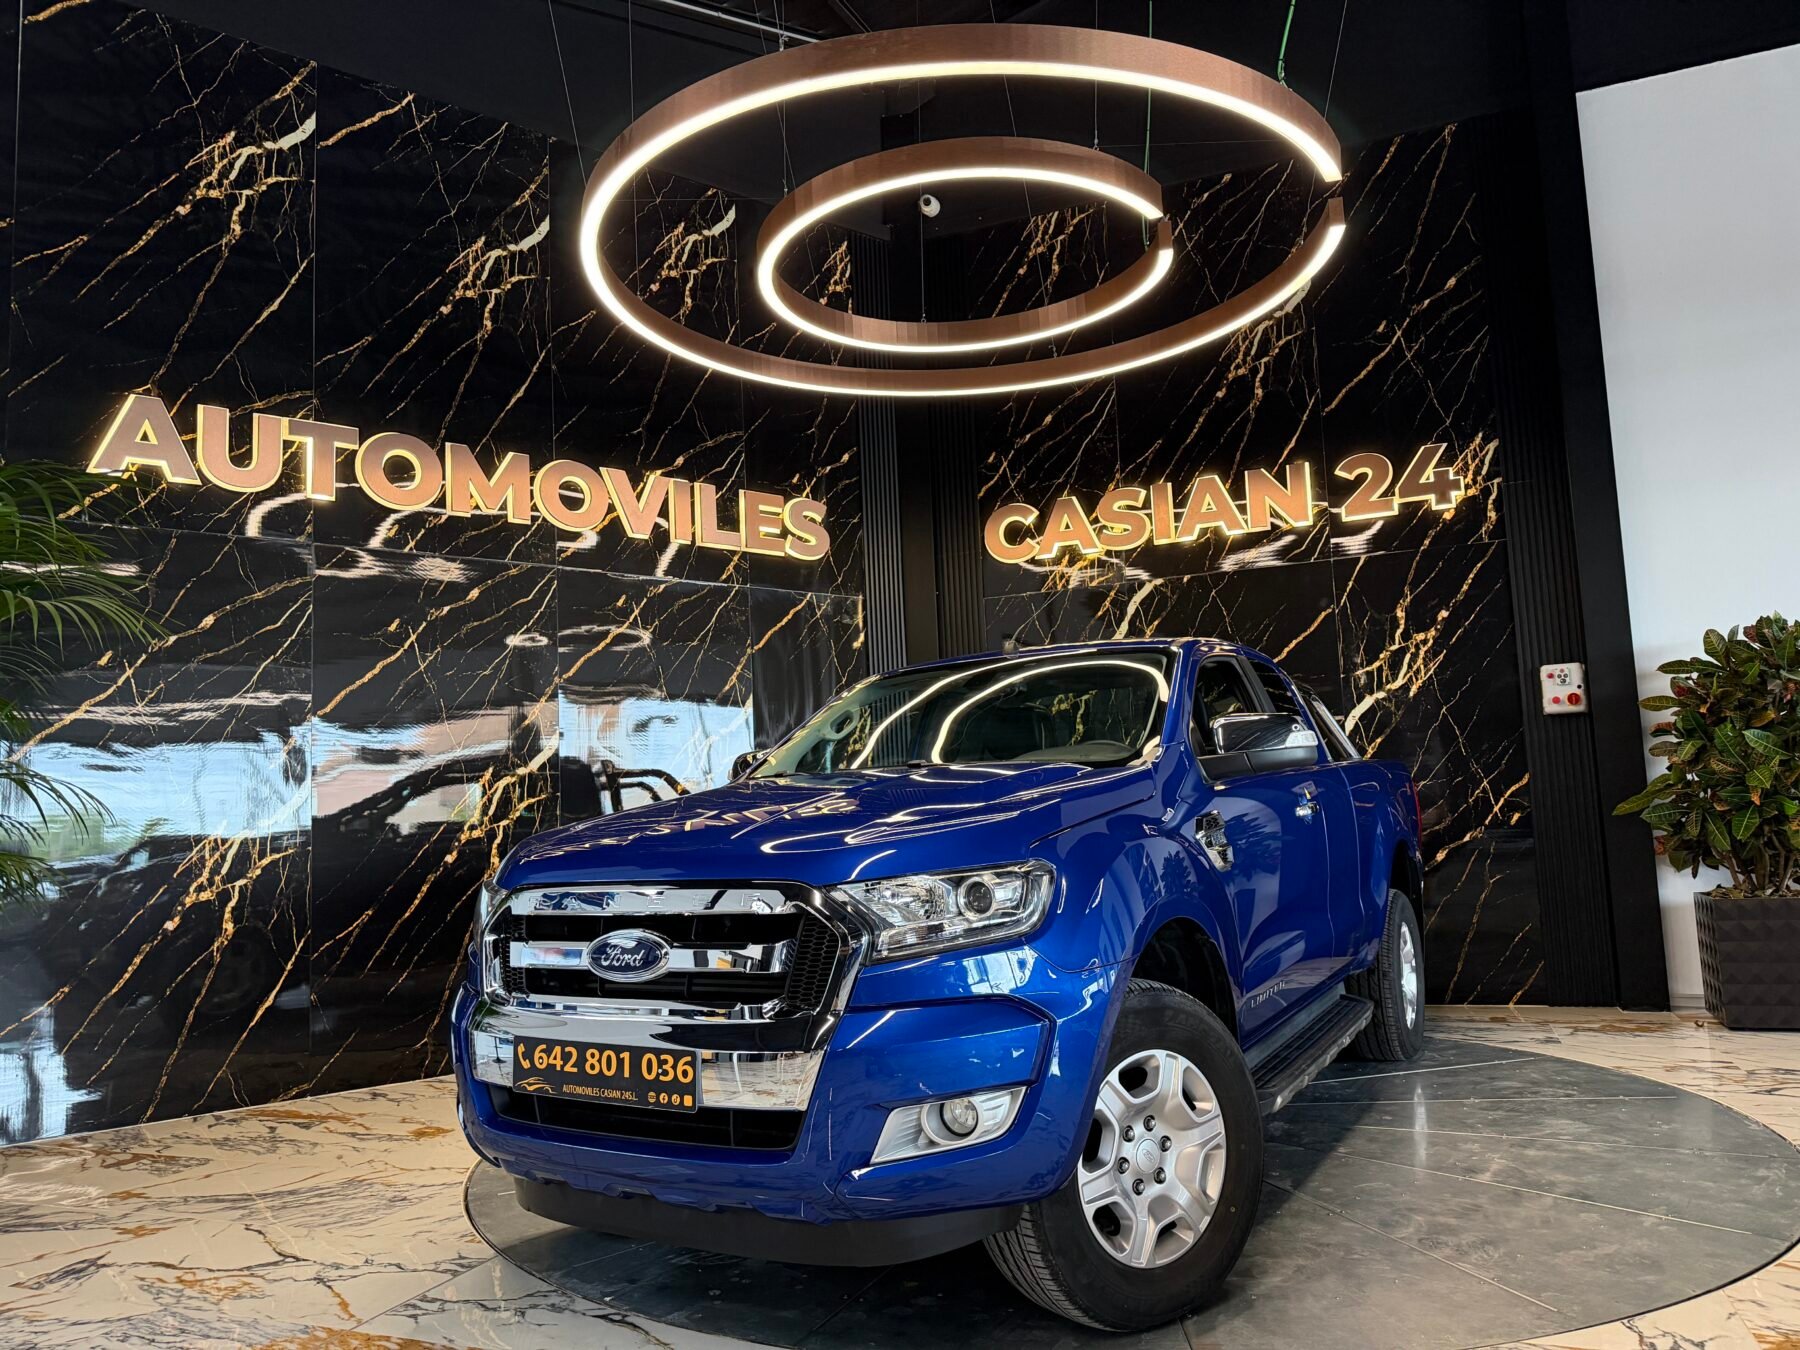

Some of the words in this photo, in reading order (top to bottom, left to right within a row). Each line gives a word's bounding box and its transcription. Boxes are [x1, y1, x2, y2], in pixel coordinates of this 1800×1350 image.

[86, 393, 831, 562] AUTOMOVILES
[983, 461, 1314, 564] CASIAN
[1334, 442, 1465, 523] 24
[600, 945, 645, 967] Ford
[533, 1044, 578, 1073] 642
[585, 1048, 630, 1078] 801
[641, 1053, 694, 1084] 036
[562, 1084, 600, 1097] AUTOMOVILES
[600, 1087, 621, 1099] CASIAN
